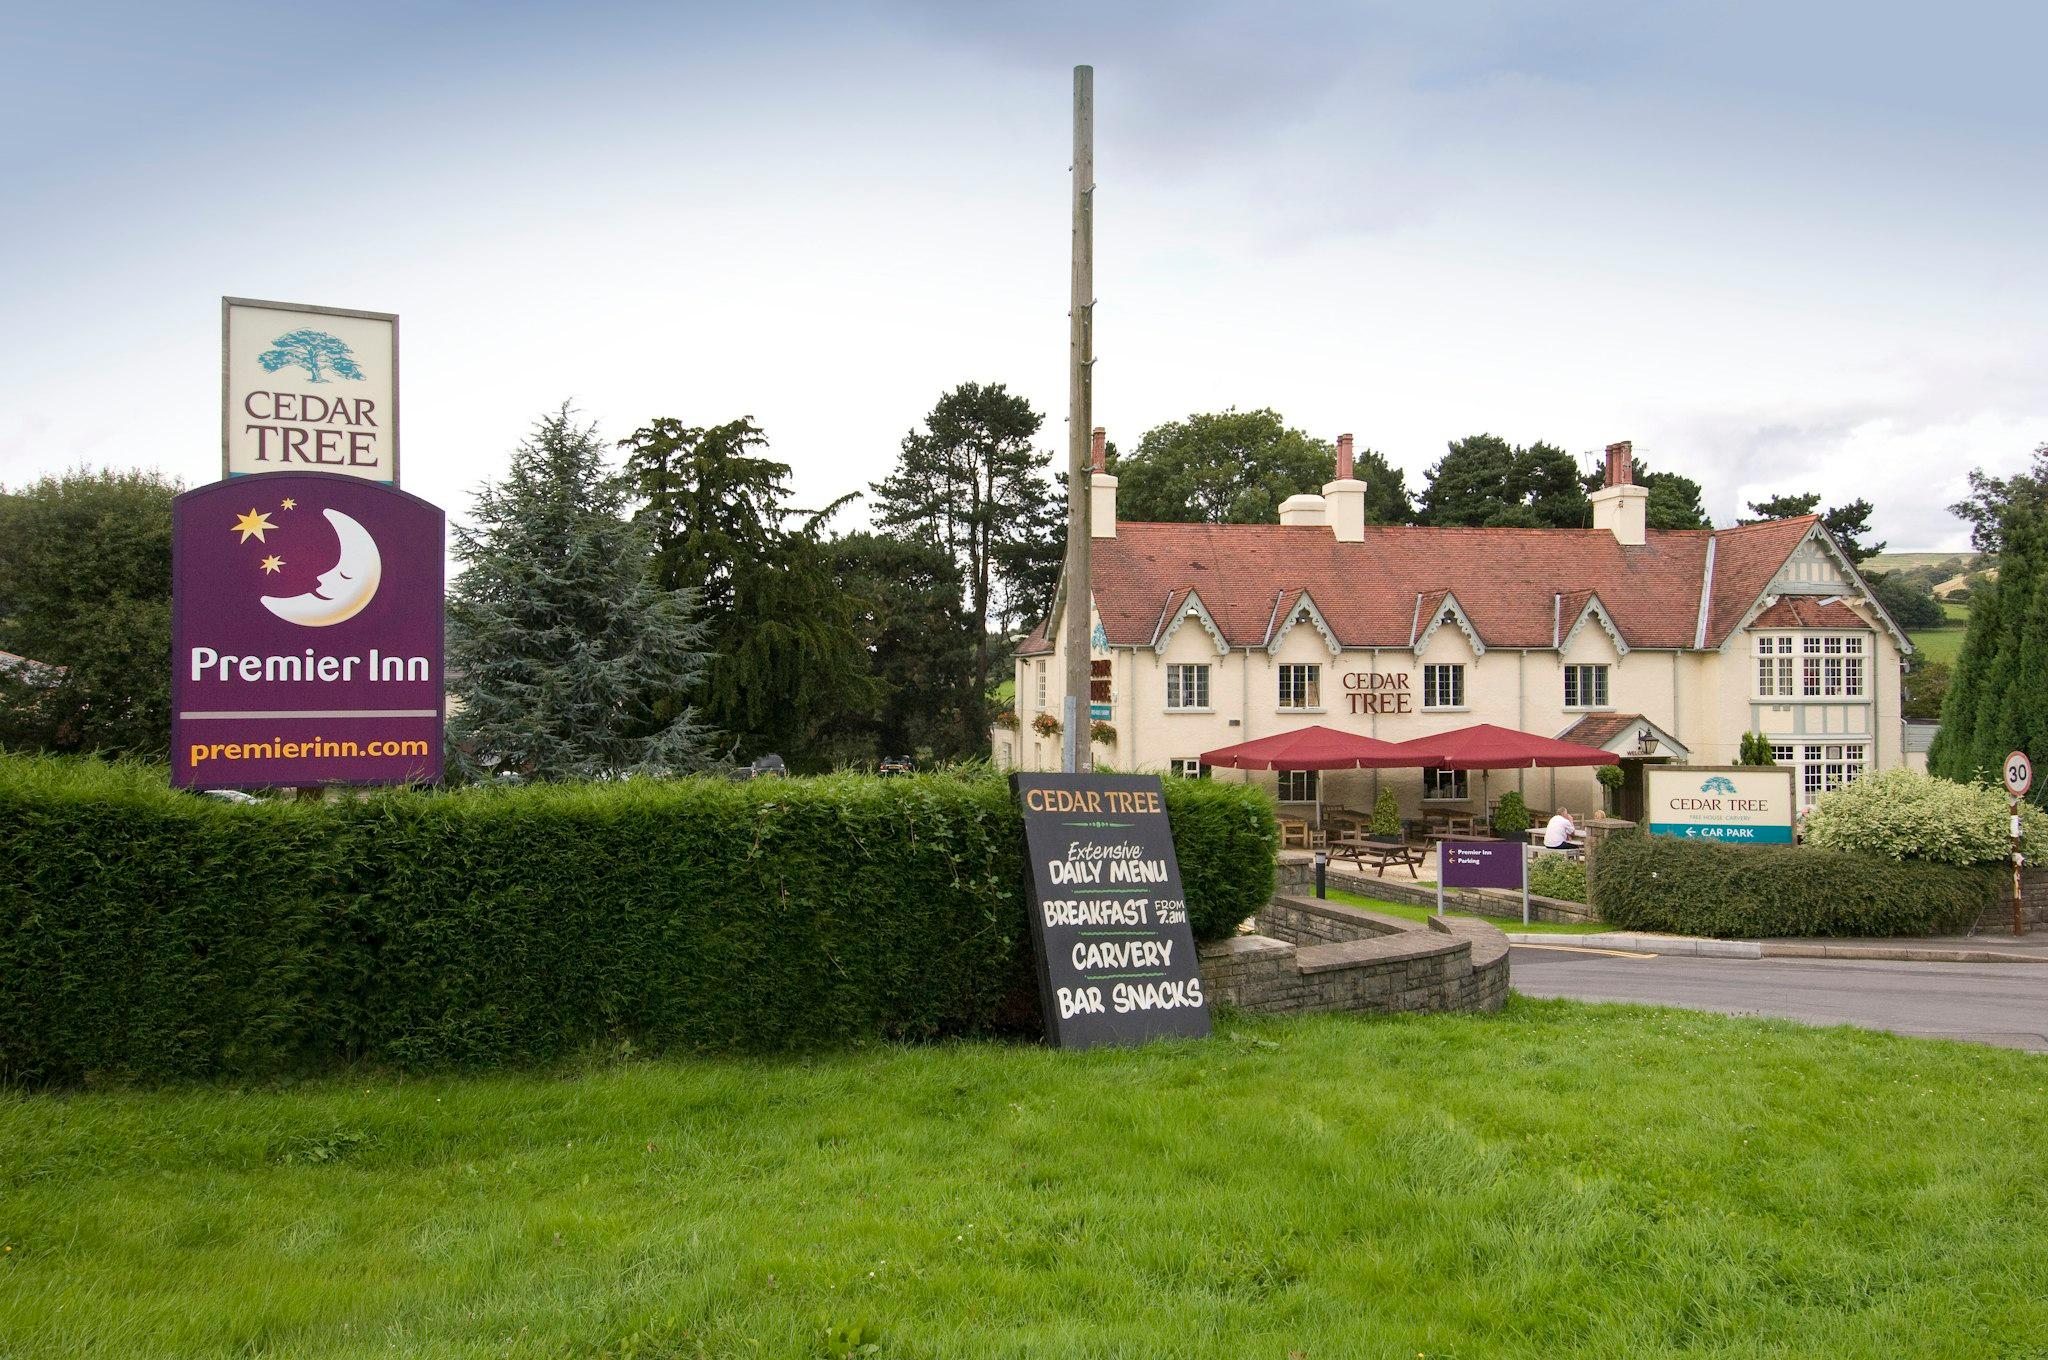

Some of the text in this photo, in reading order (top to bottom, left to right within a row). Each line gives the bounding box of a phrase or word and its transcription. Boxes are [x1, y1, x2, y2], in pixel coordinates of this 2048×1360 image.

[245, 390, 379, 427] CEDAR
[245, 424, 378, 467] TREE
[191, 647, 429, 681] Premier Inn
[1343, 672, 1410, 690] CEDAR
[1345, 692, 1413, 714] TREE
[191, 736, 428, 767] premierinn.com
[2009, 764, 2027, 783] 30
[1026, 789, 1161, 814] CEDAR TREE
[1669, 798, 1768, 812] CEDAR TREE
[1701, 828, 1754, 838] CAR PARK
[1067, 840, 1144, 861] Extensive
[1048, 860, 1168, 885] DAILY MENU
[1042, 898, 1149, 927] BREAKFAST
[1154, 899, 1185, 910] FROM
[1071, 939, 1174, 970] CARVERY
[1056, 977, 1204, 1019] BAR SNACKS
